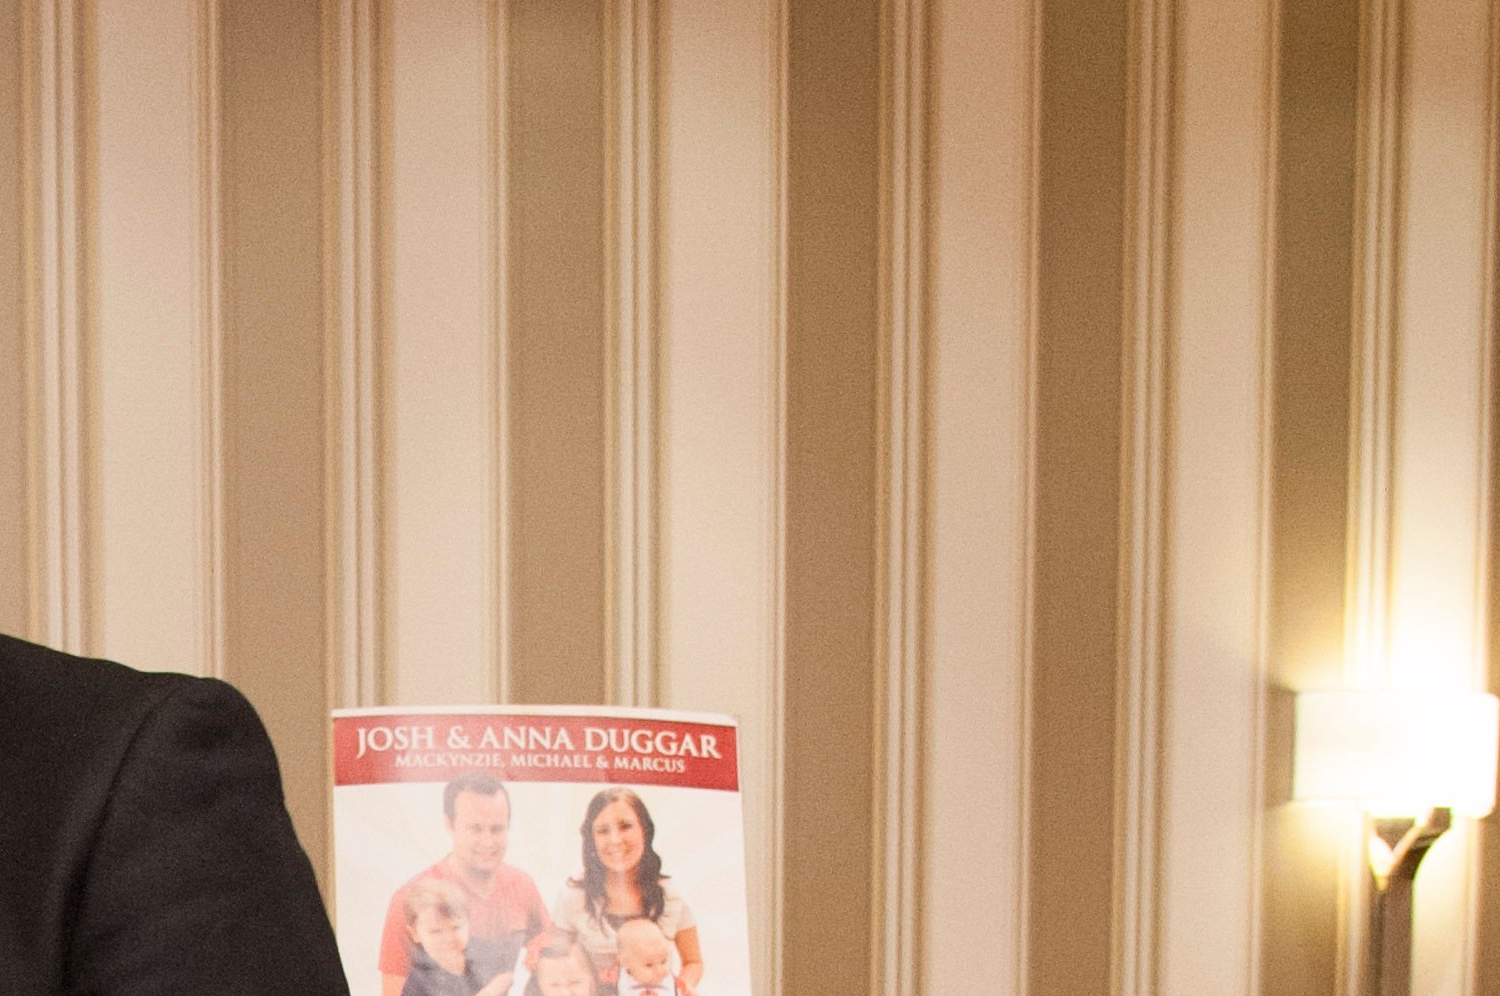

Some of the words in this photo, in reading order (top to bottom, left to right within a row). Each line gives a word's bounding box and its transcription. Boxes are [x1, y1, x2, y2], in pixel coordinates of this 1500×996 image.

[356, 727, 434, 759] JOSH
[446, 728, 471, 749] &
[479, 727, 574, 752] ANNA
[584, 727, 722, 760] DUGGAR
[510, 753, 592, 769] MICHAEL
[595, 757, 609, 769] &
[613, 756, 685, 773] MARCUS
